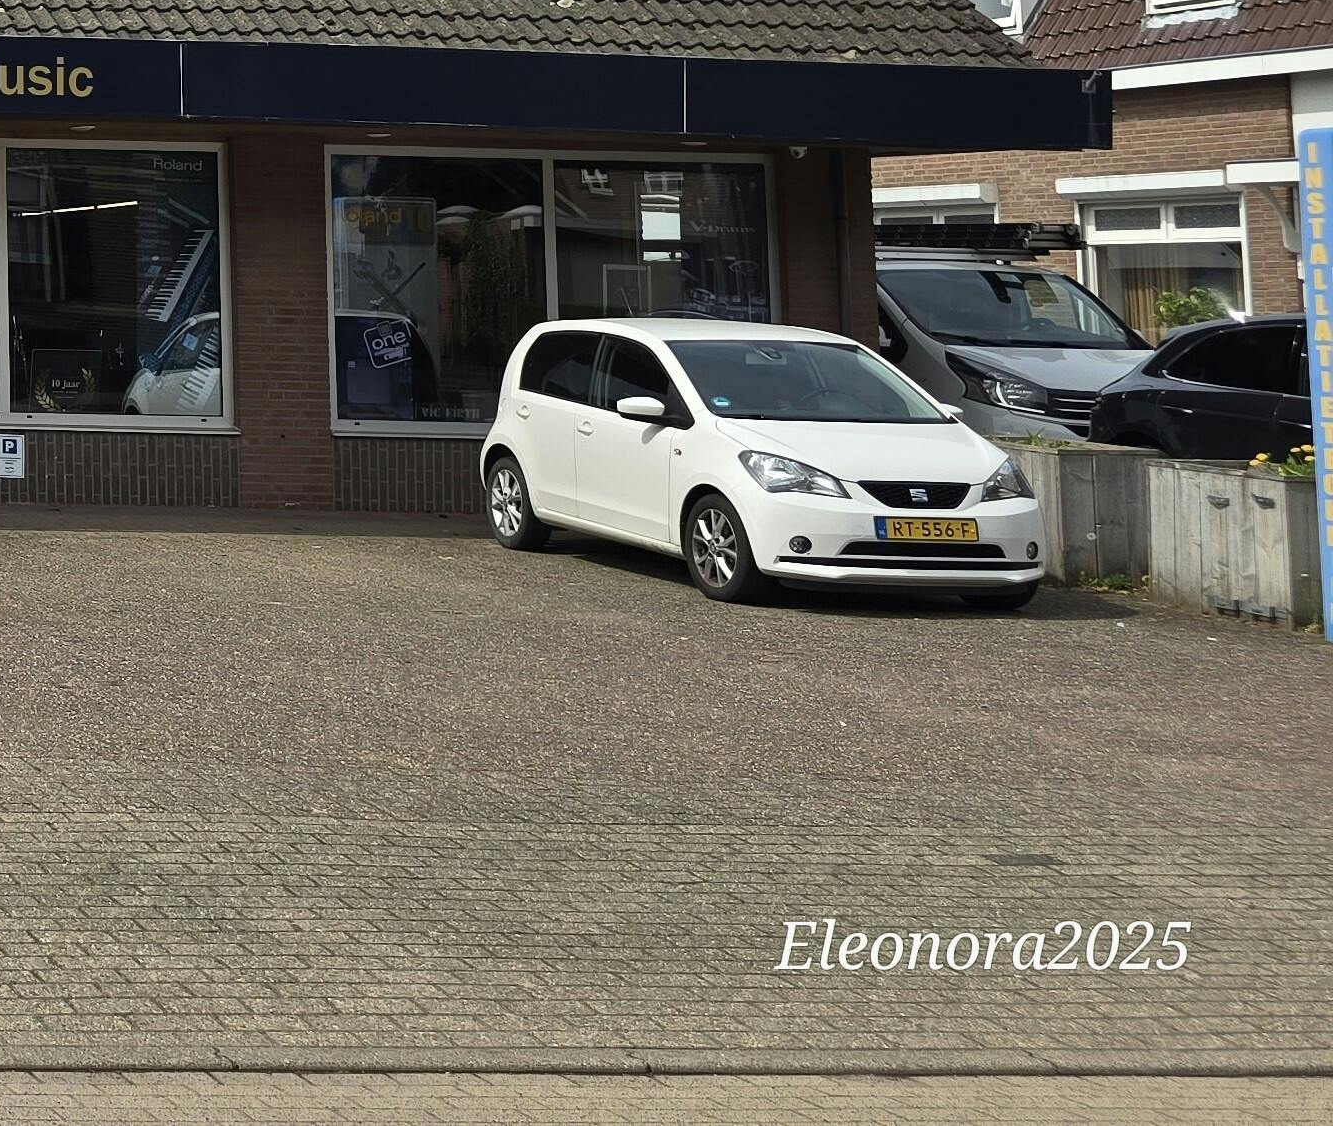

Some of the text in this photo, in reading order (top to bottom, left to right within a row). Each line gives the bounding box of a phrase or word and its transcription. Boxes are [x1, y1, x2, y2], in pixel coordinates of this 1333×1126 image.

[153, 158, 204, 171] Roland
[372, 332, 407, 350] one
[52, 379, 61, 388] 10
[893, 522, 970, 537] RT-556-F
